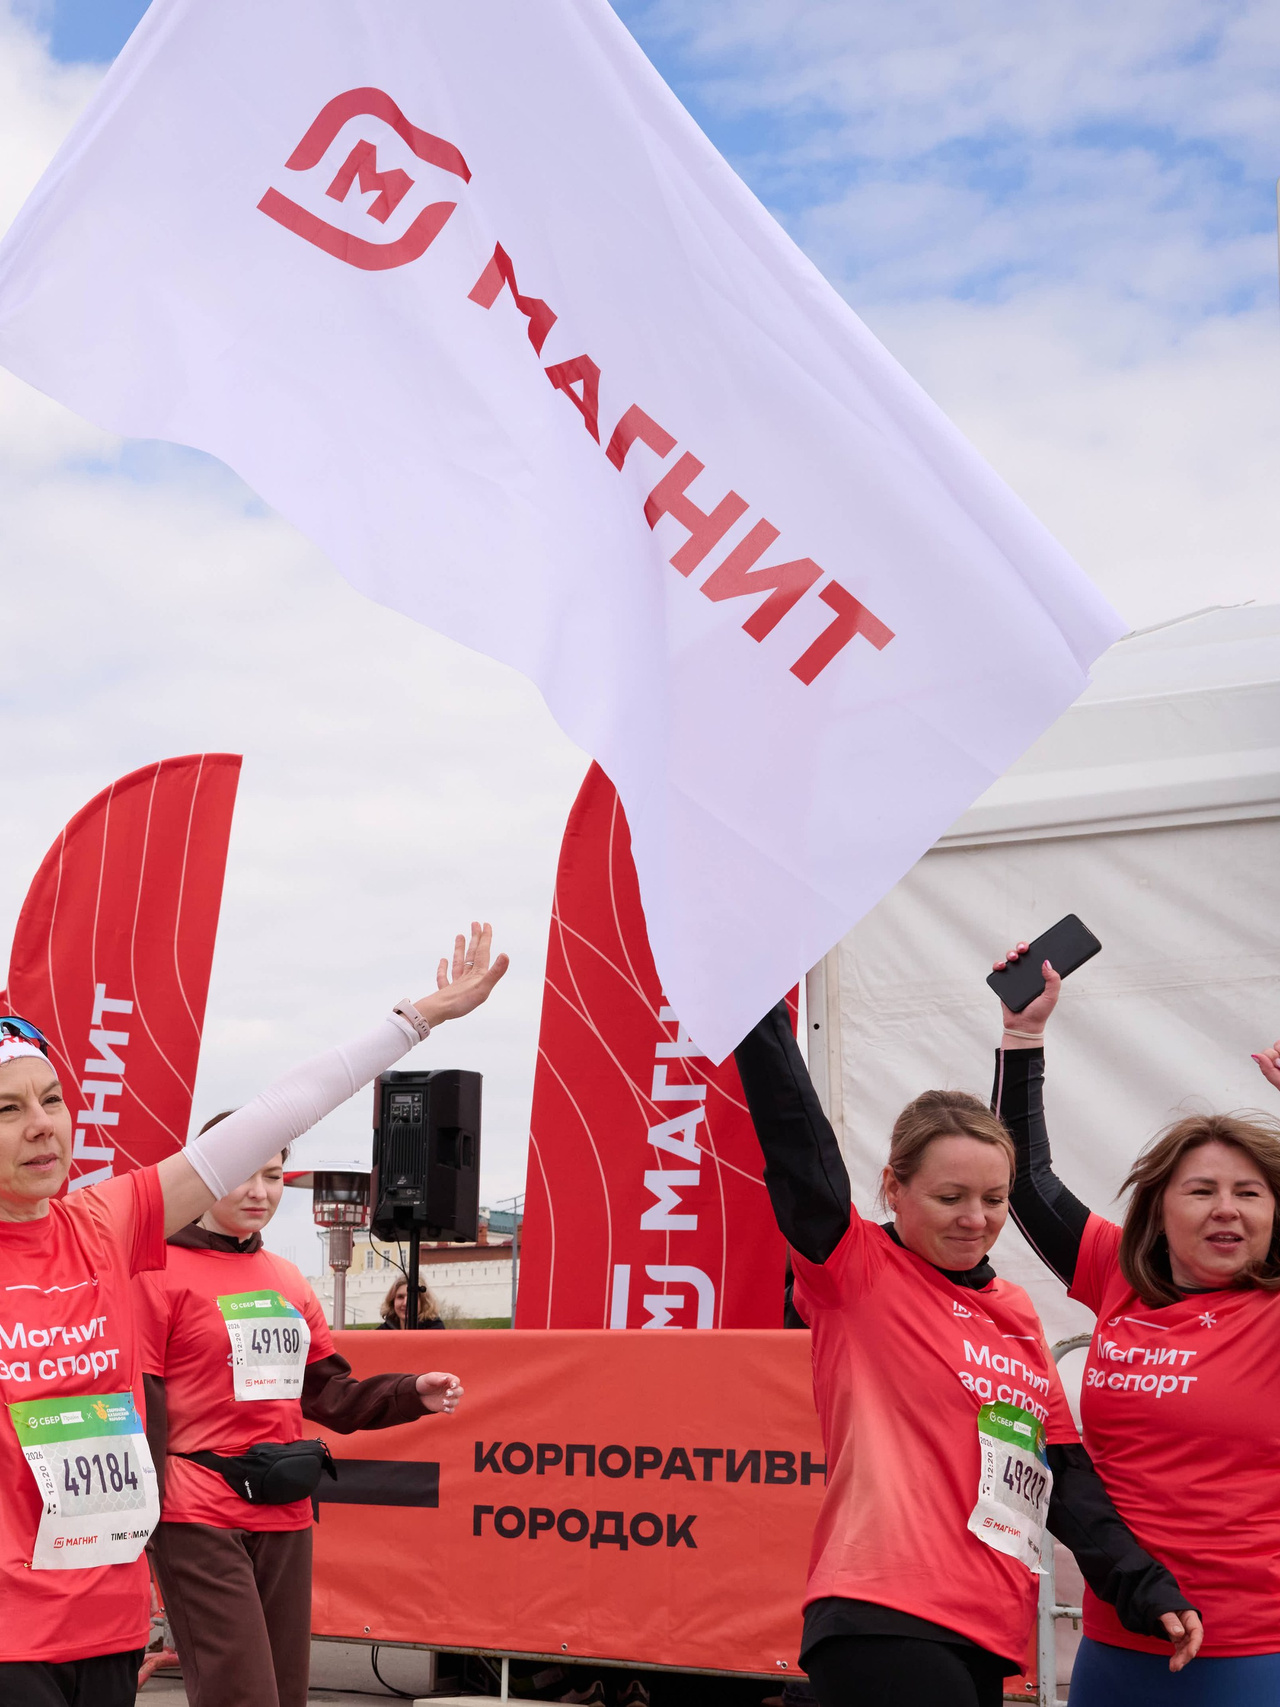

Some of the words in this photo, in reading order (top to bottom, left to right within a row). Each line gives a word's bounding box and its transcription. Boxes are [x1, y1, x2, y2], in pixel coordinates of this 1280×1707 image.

[467, 240, 896, 686] МАГНИТ
[235, 1333, 243, 1353] 12:20
[252, 1328, 300, 1354] 49180
[1097, 1334, 1197, 1366] Магнит
[39, 1349, 120, 1380] спорт
[963, 1340, 1050, 1397] Магнит
[957, 1371, 992, 1399] за
[1086, 1368, 1106, 1388] за
[1108, 1372, 1198, 1398] спорт
[39, 1415, 60, 1427] СБЕР
[996, 1416, 1013, 1428] СБЕР
[26, 1451, 44, 1461] 2026
[474, 1441, 827, 1486] КОРПОРАТИВН
[39, 1465, 55, 1495] 12:20
[63, 1452, 138, 1497] 49184
[1003, 1456, 1046, 1509] 49217
[66, 1535, 98, 1547] МАГНИТ
[473, 1504, 698, 1551] ГОРОДОК
[993, 1522, 1021, 1538] МАГНИТ
